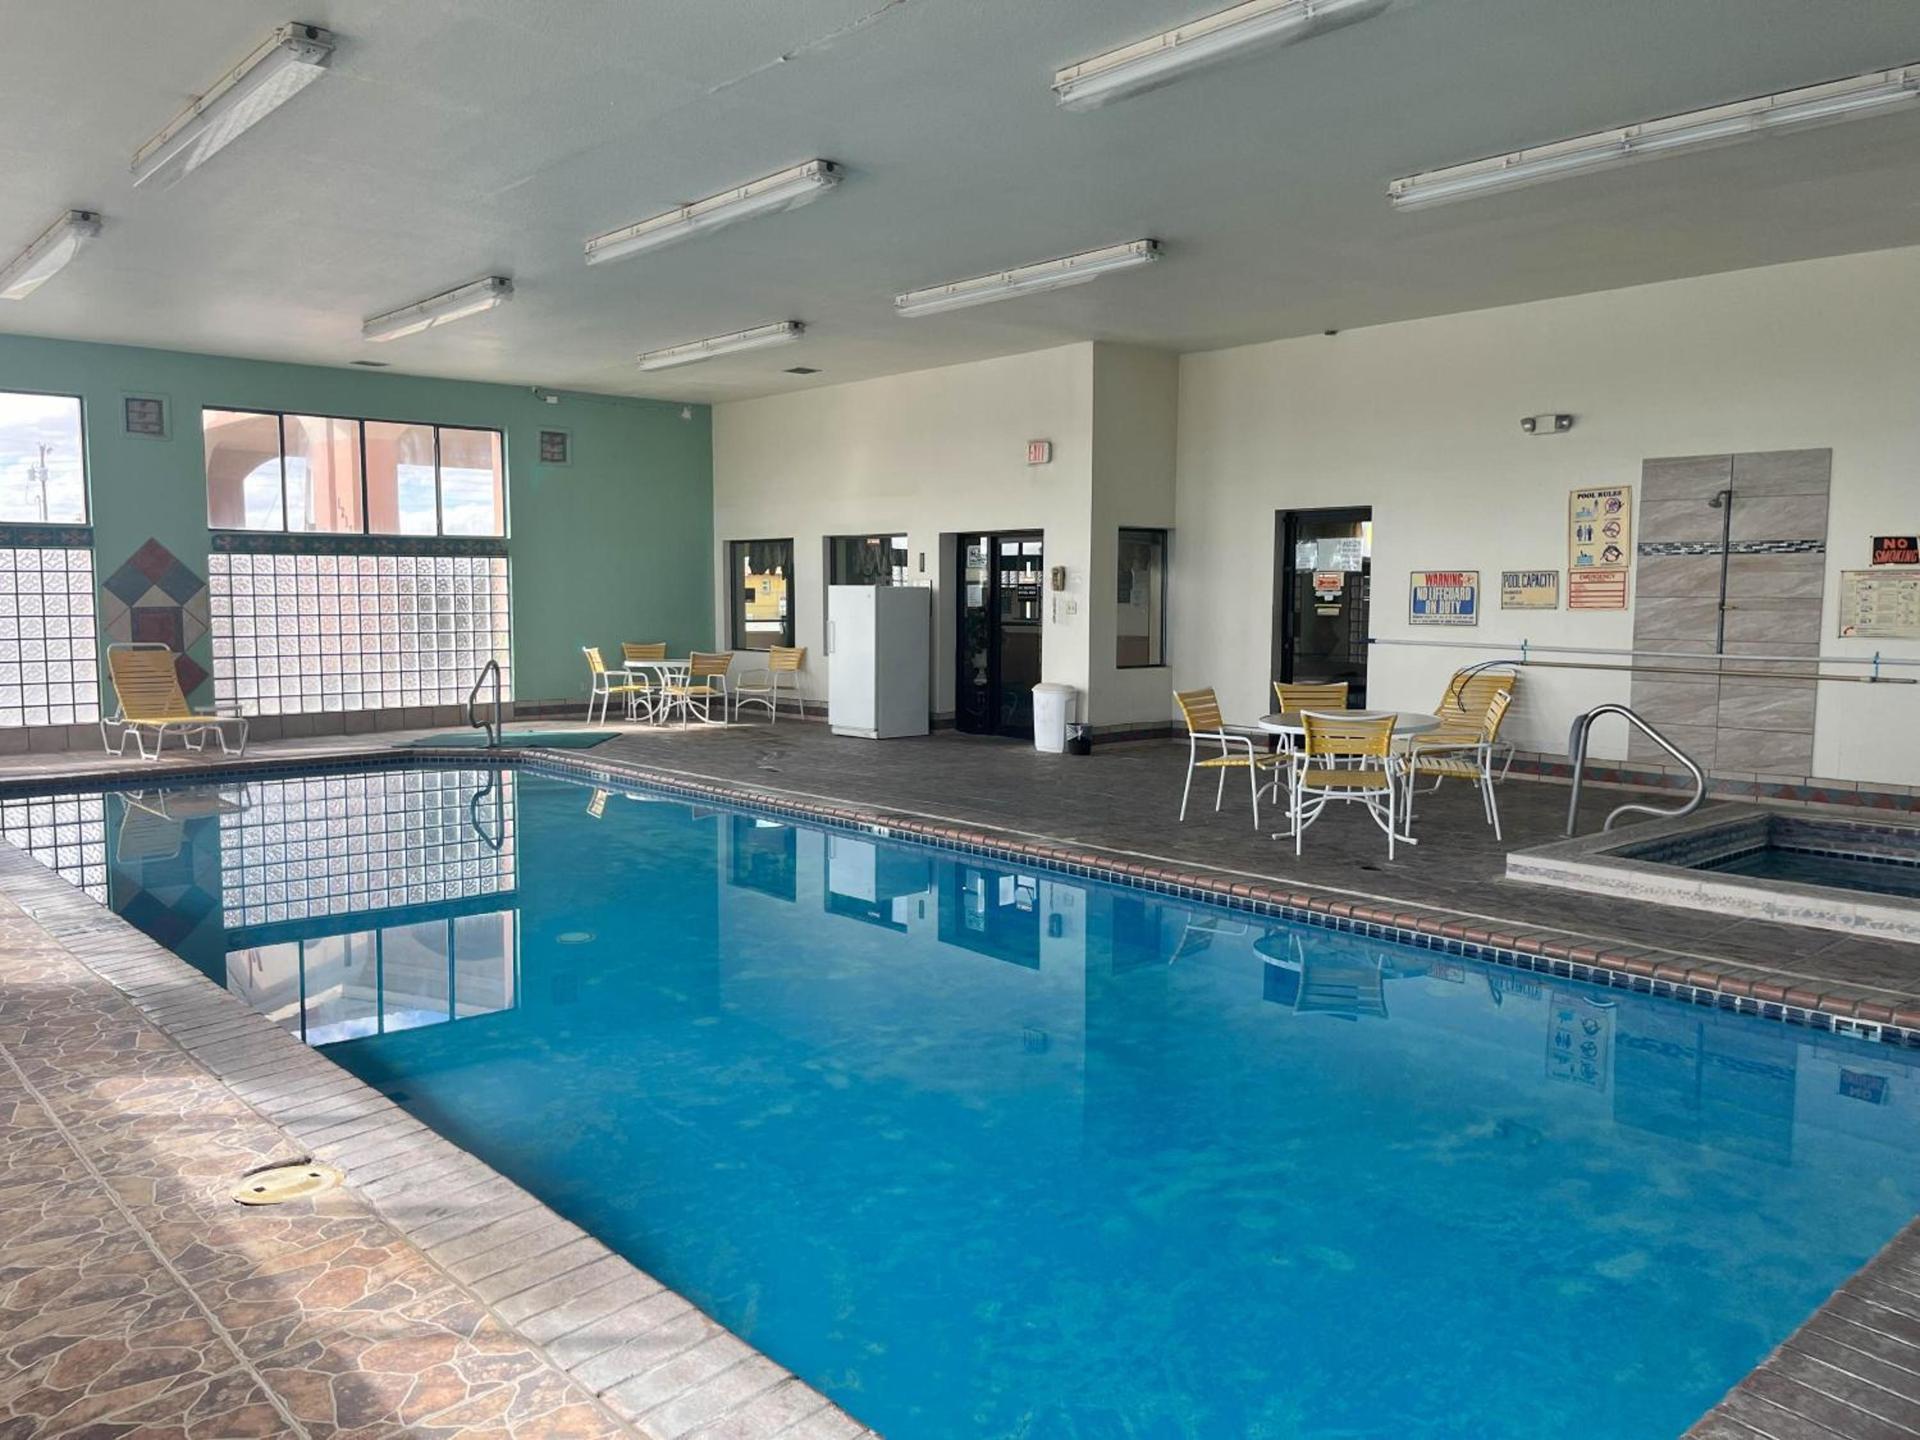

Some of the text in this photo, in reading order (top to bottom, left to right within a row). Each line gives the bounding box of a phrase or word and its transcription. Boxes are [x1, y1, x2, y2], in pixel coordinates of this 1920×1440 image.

[1598, 490, 1622, 498] RULES
[1884, 539, 1908, 549] NO
[1875, 550, 1918, 563] SMOKING
[1425, 573, 1464, 587] WARNING
[1503, 573, 1556, 588] POOL CAPACITY
[1416, 587, 1471, 601] NO LIFEGUARD
[1425, 600, 1461, 614] ON DUTY
